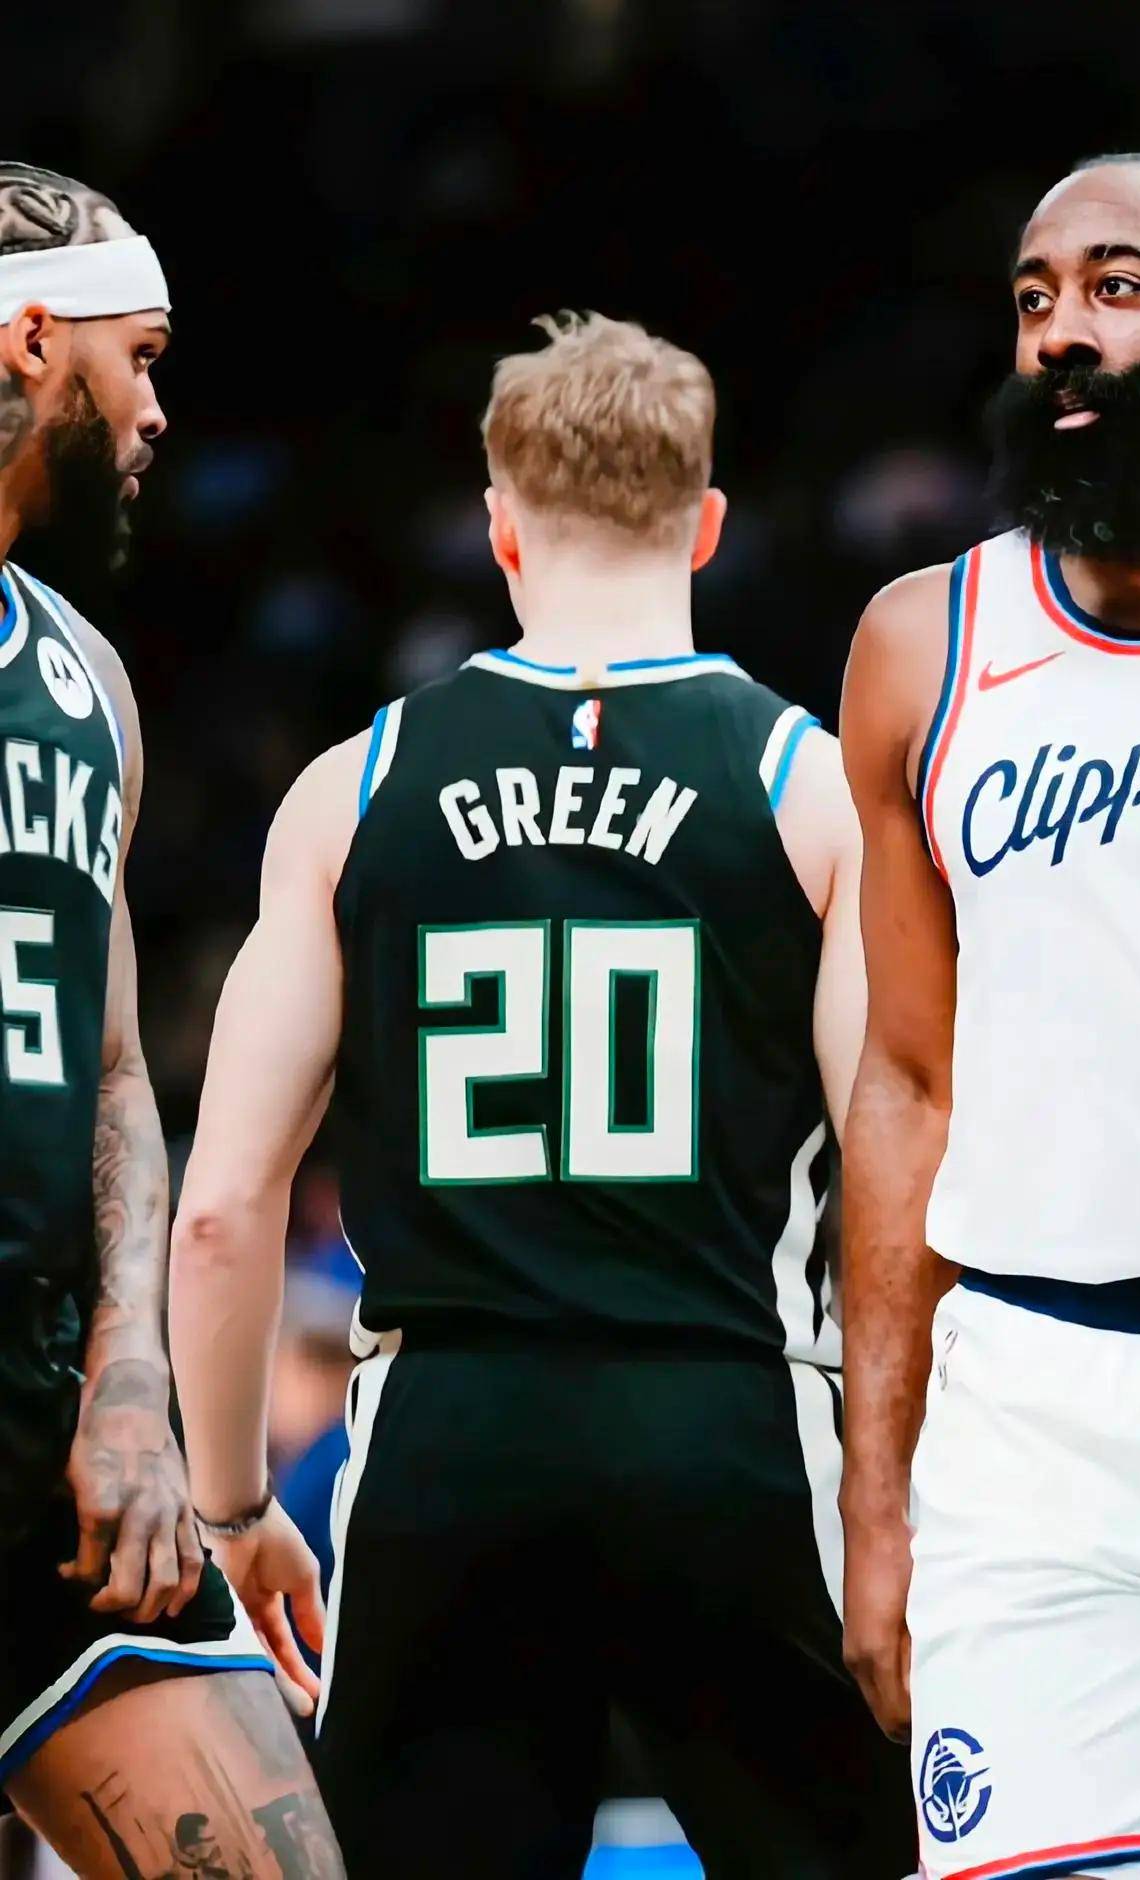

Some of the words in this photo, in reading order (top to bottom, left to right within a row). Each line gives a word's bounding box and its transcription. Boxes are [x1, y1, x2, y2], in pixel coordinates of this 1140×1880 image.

[0, 737, 122, 907] CKS
[438, 765, 698, 866] GREEN
[0, 905, 68, 1087] 5
[417, 918, 701, 1186] 20
